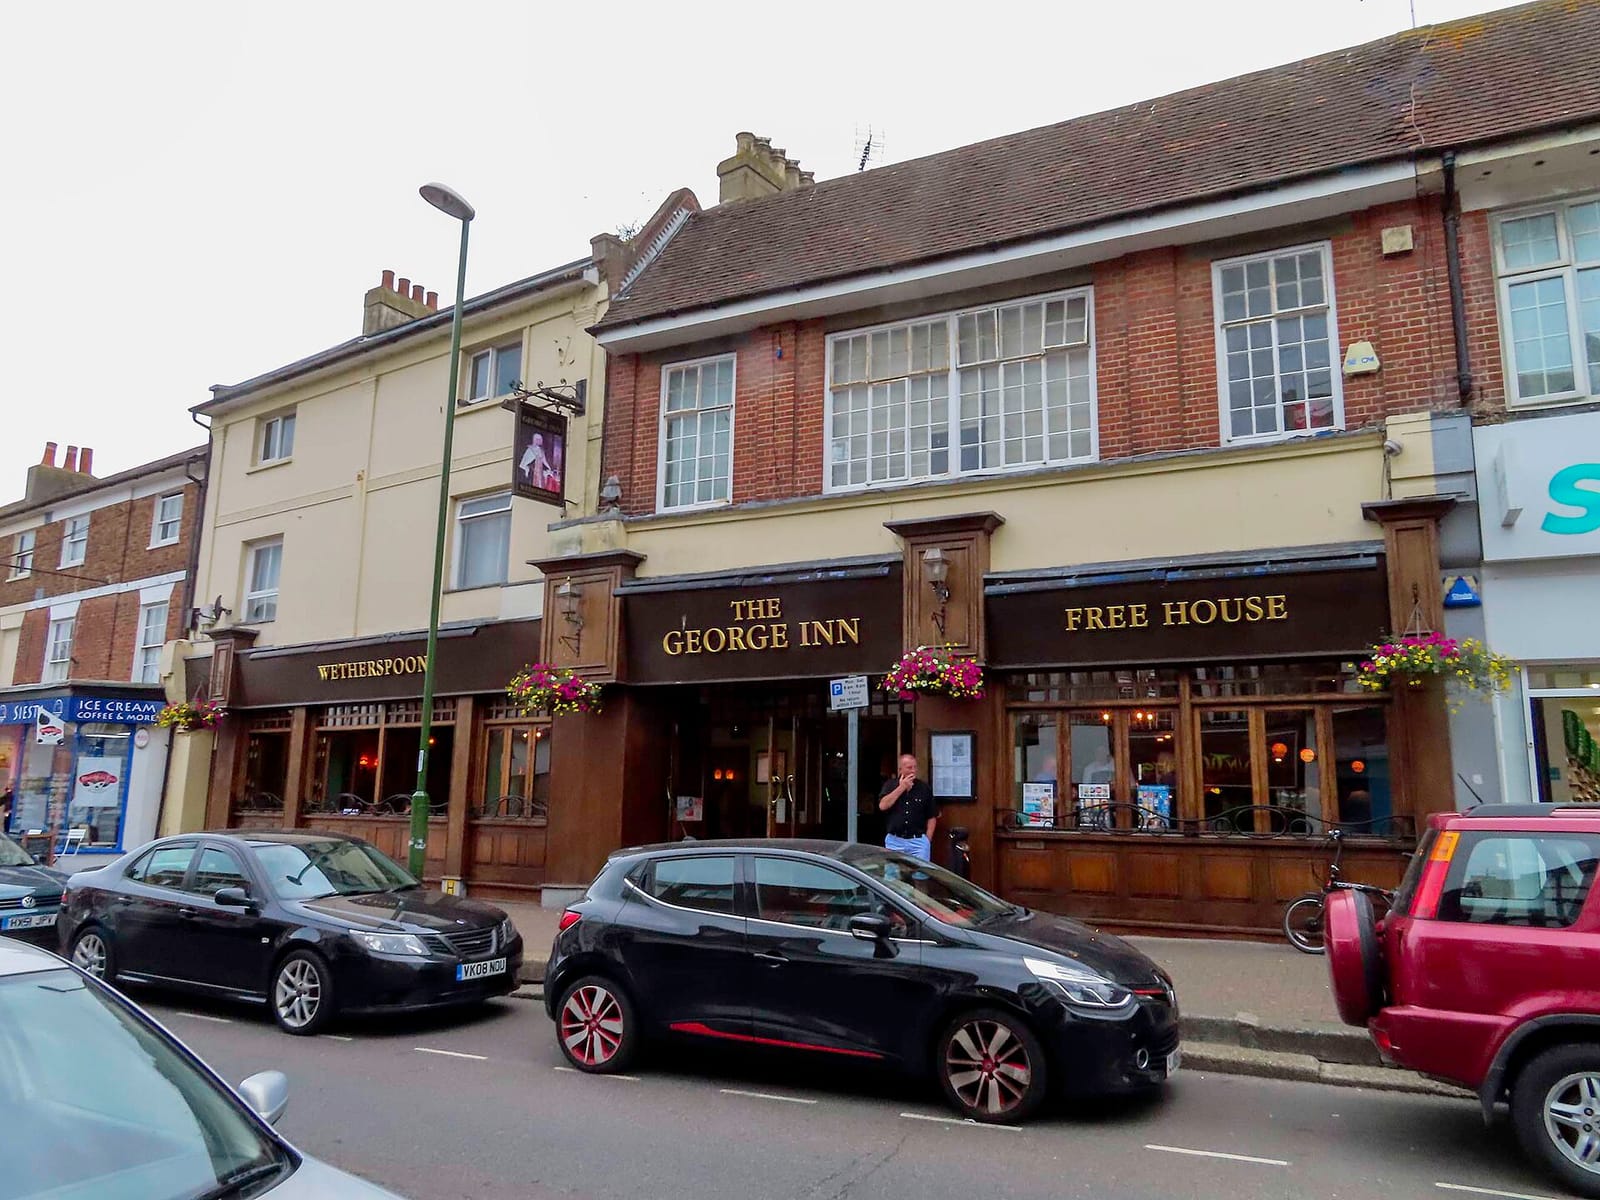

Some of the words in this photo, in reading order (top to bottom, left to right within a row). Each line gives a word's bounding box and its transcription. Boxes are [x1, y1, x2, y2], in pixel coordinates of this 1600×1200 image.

[730, 597, 782, 621] THE
[1064, 603, 1149, 631] FREE
[1161, 594, 1289, 626] HOUSE
[662, 623, 789, 656] GEORGE
[799, 617, 861, 647] INN
[76, 711, 114, 720] COFFEE
[116, 712, 124, 720] &
[126, 714, 156, 722] MORE
[79, 700, 102, 711] ICE
[105, 701, 156, 714] CREAM
[463, 962, 488, 977] VK08
